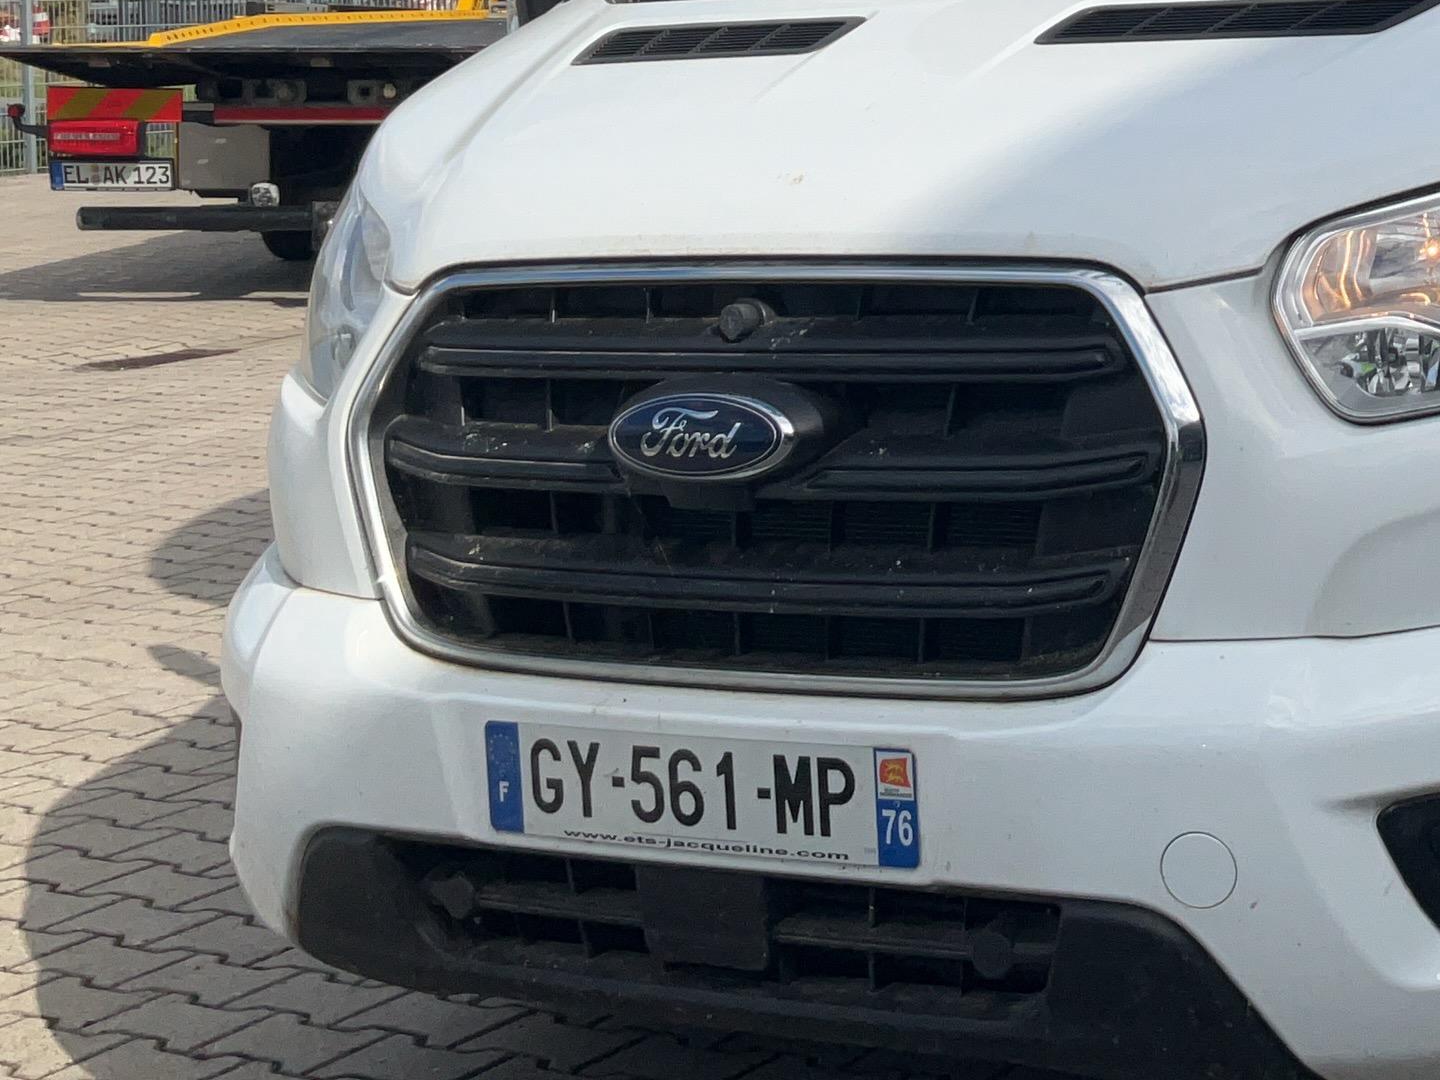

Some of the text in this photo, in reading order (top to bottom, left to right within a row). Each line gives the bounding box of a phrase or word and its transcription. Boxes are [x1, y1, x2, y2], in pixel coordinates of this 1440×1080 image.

[64, 165, 170, 185] EL AK 123
[640, 407, 741, 459] Ford
[499, 780, 509, 802] F
[530, 738, 855, 837] GY-561-MP
[882, 809, 914, 846] 76
[564, 829, 849, 861] www.ets-jacqueline.com
